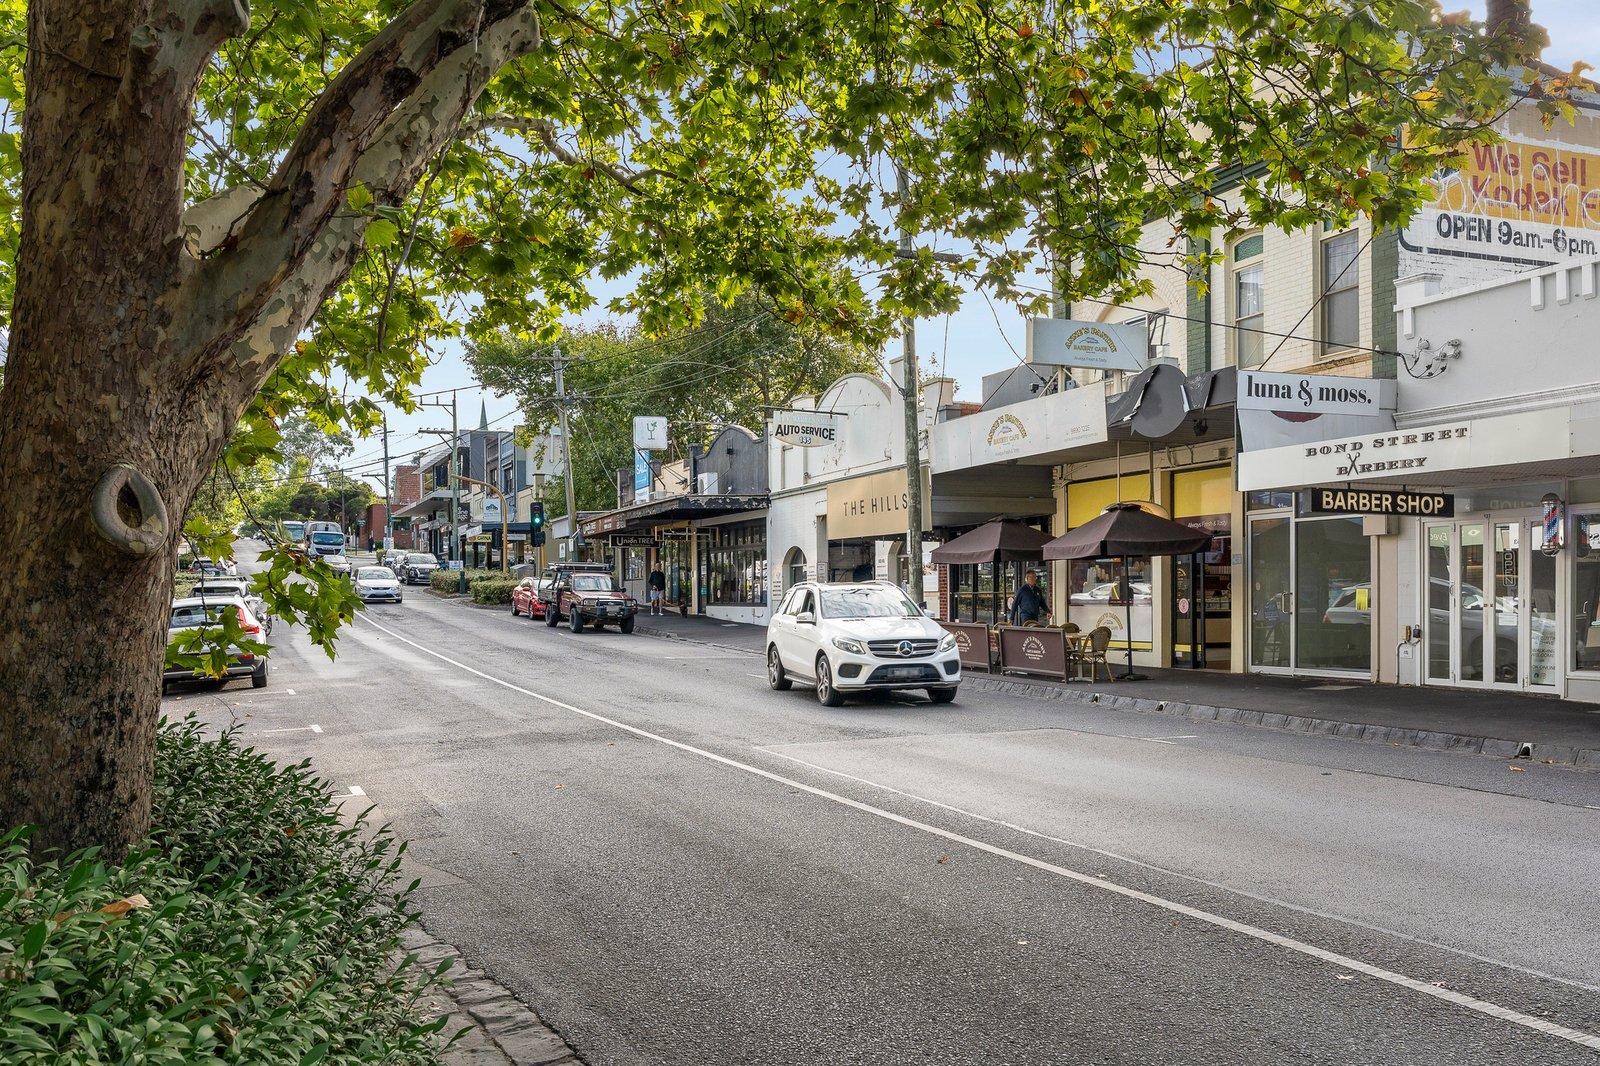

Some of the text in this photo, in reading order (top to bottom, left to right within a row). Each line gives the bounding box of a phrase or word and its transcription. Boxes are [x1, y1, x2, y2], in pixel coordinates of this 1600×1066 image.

[1473, 144, 1586, 186] We Sell
[1436, 213, 1492, 243] OPEN
[1247, 375, 1372, 407] luna & moss.
[775, 424, 835, 441] AUTO SERVICE
[1305, 427, 1468, 457] BOND STREET
[843, 493, 908, 517] THE HILLS
[1322, 490, 1445, 514] BARBER SHOP
[616, 536, 638, 546] Union
[1504, 552, 1514, 585] OPEN
